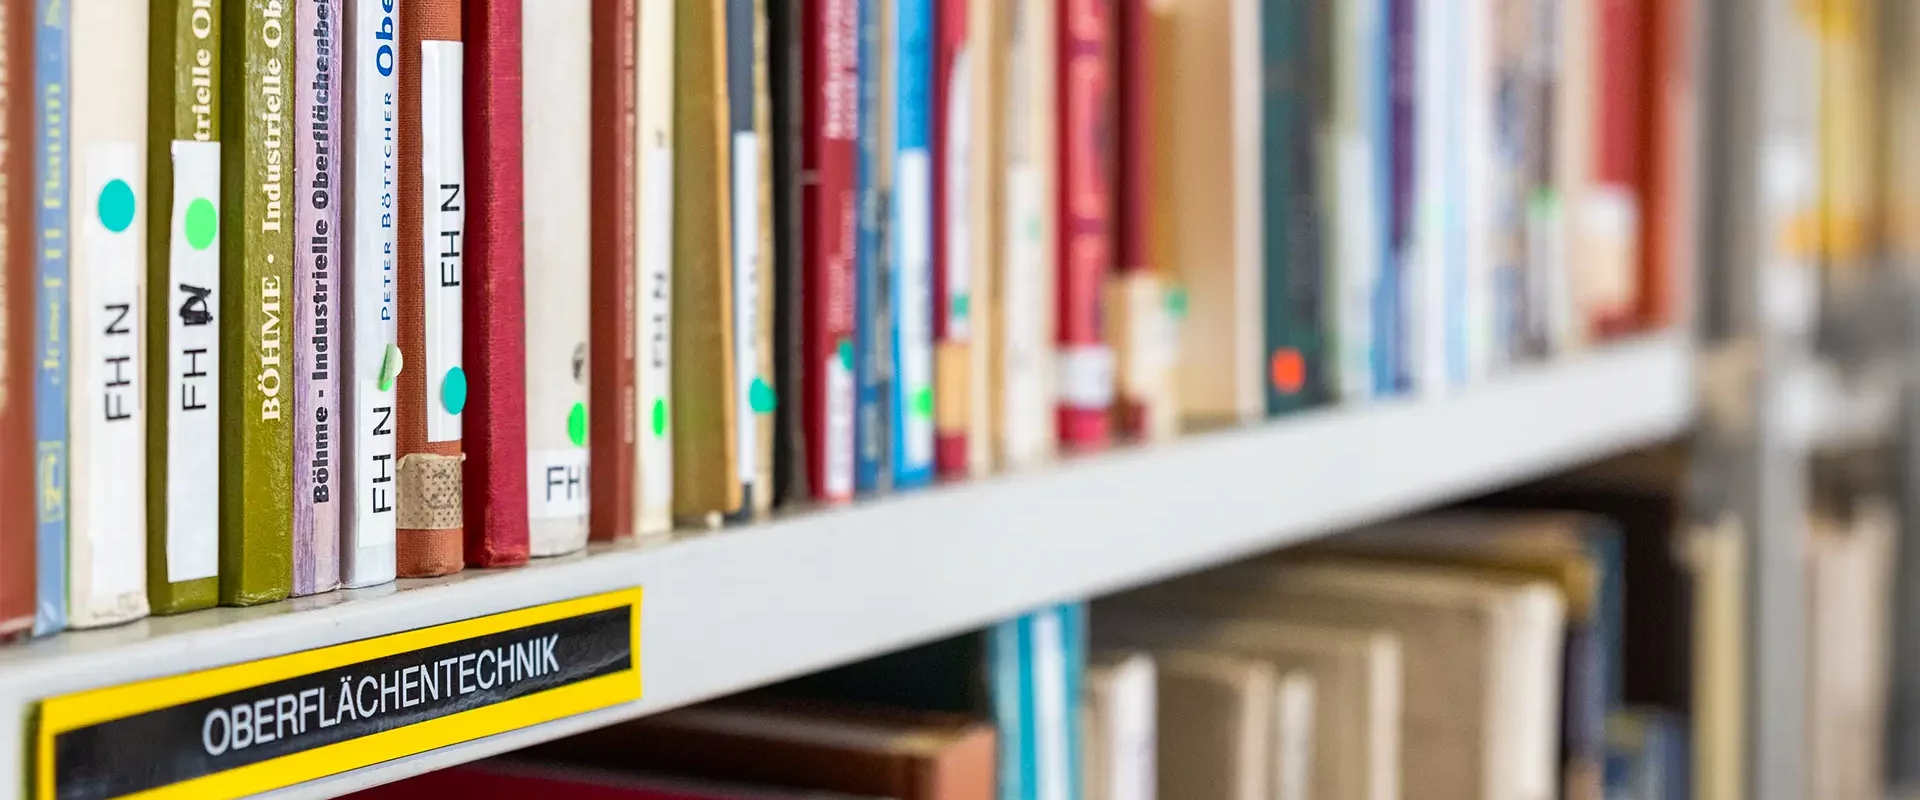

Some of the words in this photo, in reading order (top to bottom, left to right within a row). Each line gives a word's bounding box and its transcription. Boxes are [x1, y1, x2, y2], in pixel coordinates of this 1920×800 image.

[312, 0, 330, 210] Oberflächenbe
[261, 57, 282, 234] Industrielle
[381, 92, 393, 229] BÖTTCHER
[440, 184, 461, 212] N
[381, 242, 392, 321] PETER
[440, 230, 461, 288] FH
[104, 303, 131, 336] N
[311, 219, 329, 381] Industrielle
[182, 348, 207, 411] FH
[256, 275, 281, 422] BÖHME
[104, 356, 131, 422] FH
[372, 406, 392, 436] N
[312, 406, 330, 504] Böhme
[372, 454, 392, 514] FH
[203, 633, 560, 757] OBERFLÄCHENTECHNIK
